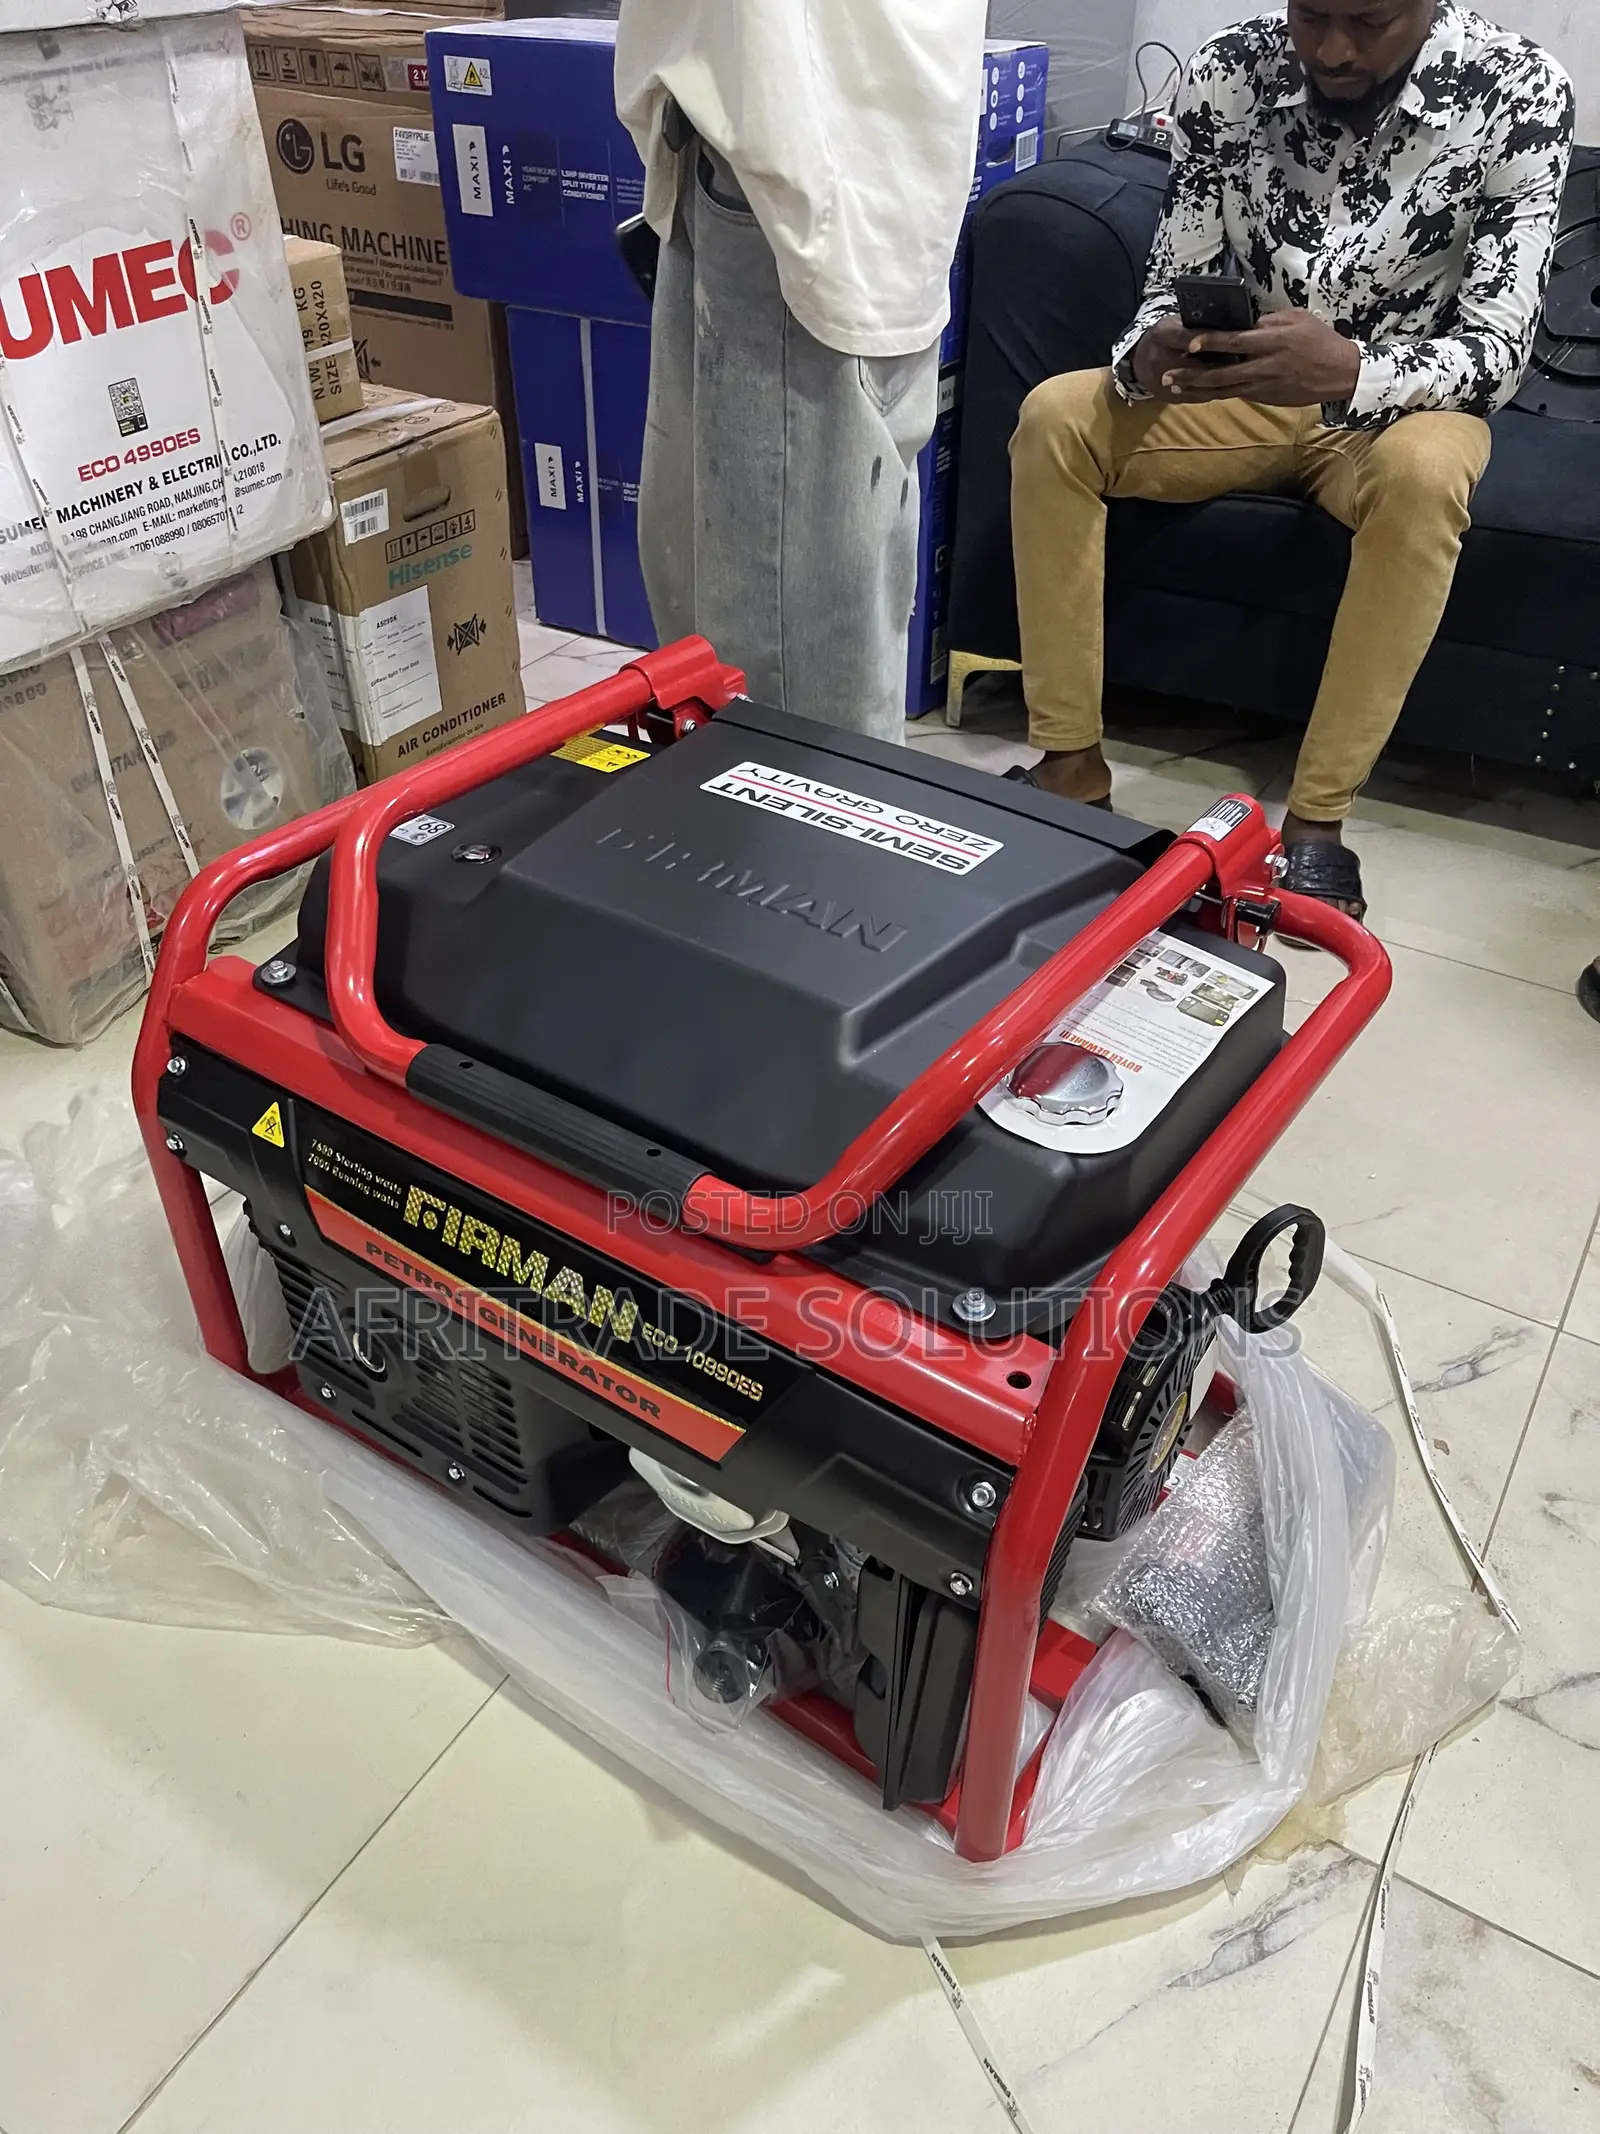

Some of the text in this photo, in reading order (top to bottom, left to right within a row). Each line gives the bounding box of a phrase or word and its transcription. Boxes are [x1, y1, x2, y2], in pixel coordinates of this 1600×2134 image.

[320, 131, 366, 173] LG
[326, 178, 377, 196] Life's Good
[470, 155, 482, 199] MAXI
[503, 159, 515, 204] MAXI
[562, 179, 608, 192] SPLIT TYPE AIR
[562, 189, 605, 200] CONDITIONER
[578, 172, 609, 182] INVERTER
[280, 216, 448, 265] HING MACHINE
[0, 229, 240, 360] UMEC
[294, 286, 309, 312] KG
[77, 427, 201, 482] ECO 4990ES
[56, 480, 143, 523] MACHINERY
[148, 475, 160, 491] &
[162, 453, 223, 486] ELECTRI
[231, 433, 282, 461] CO.,LTD.
[548, 466, 557, 498] MAXI
[575, 470, 585, 503] MAXI
[90, 506, 146, 535] CHANGJIANG
[148, 497, 174, 515] ROAD,
[143, 512, 176, 532] E-MAIL:
[388, 543, 473, 589] Hisense
[397, 737, 419, 758] AIR
[422, 691, 507, 744] CONDITIONER
[708, 781, 972, 872] SEMI-SILENT
[736, 767, 990, 852] ZERO GRAVITY
[1110, 1051, 1143, 1074] BUYER
[307, 1151, 400, 1210] 7000 Running watts
[311, 1138, 403, 1195] 7600 Starting watts
[403, 1184, 764, 1403] FIRMAN ECO 10990ES
[365, 1240, 662, 1420] PETROL GENERATOR
[931, 1952, 957, 1990] FIRMAN
[983, 2057, 1011, 2098] FIRMAN
